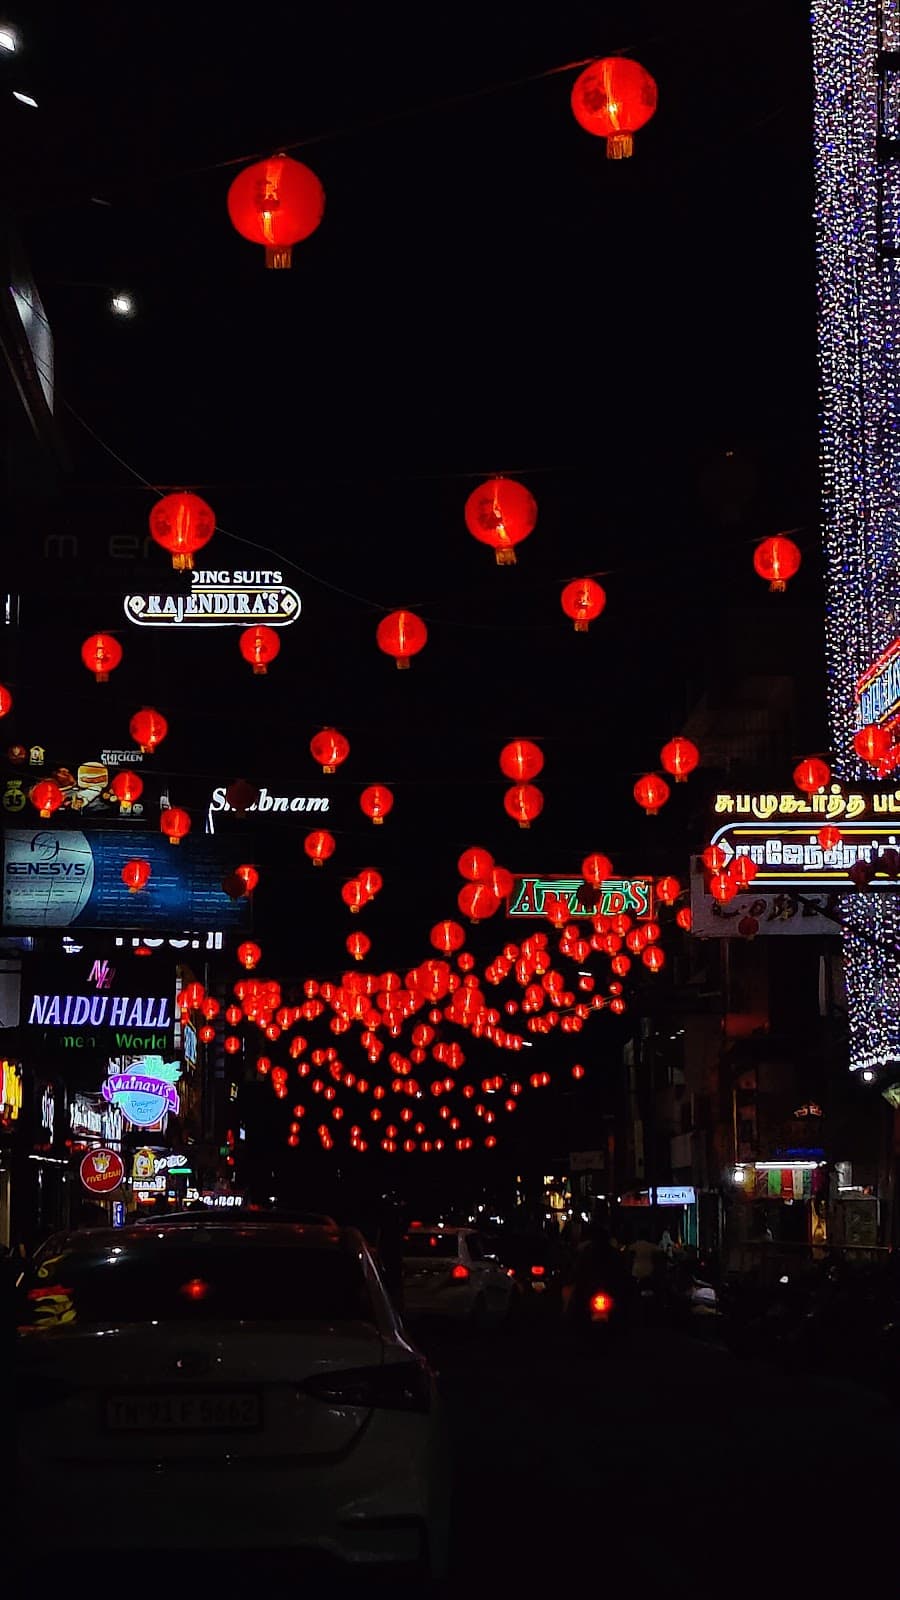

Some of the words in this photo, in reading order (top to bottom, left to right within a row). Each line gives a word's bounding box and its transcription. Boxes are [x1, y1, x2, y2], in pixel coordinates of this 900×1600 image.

[233, 570, 283, 584] SUITS
[6, 862, 86, 876] GENESYS
[28, 995, 106, 1026] NAIDU
[109, 997, 171, 1028] HALL
[115, 1032, 167, 1050] World
